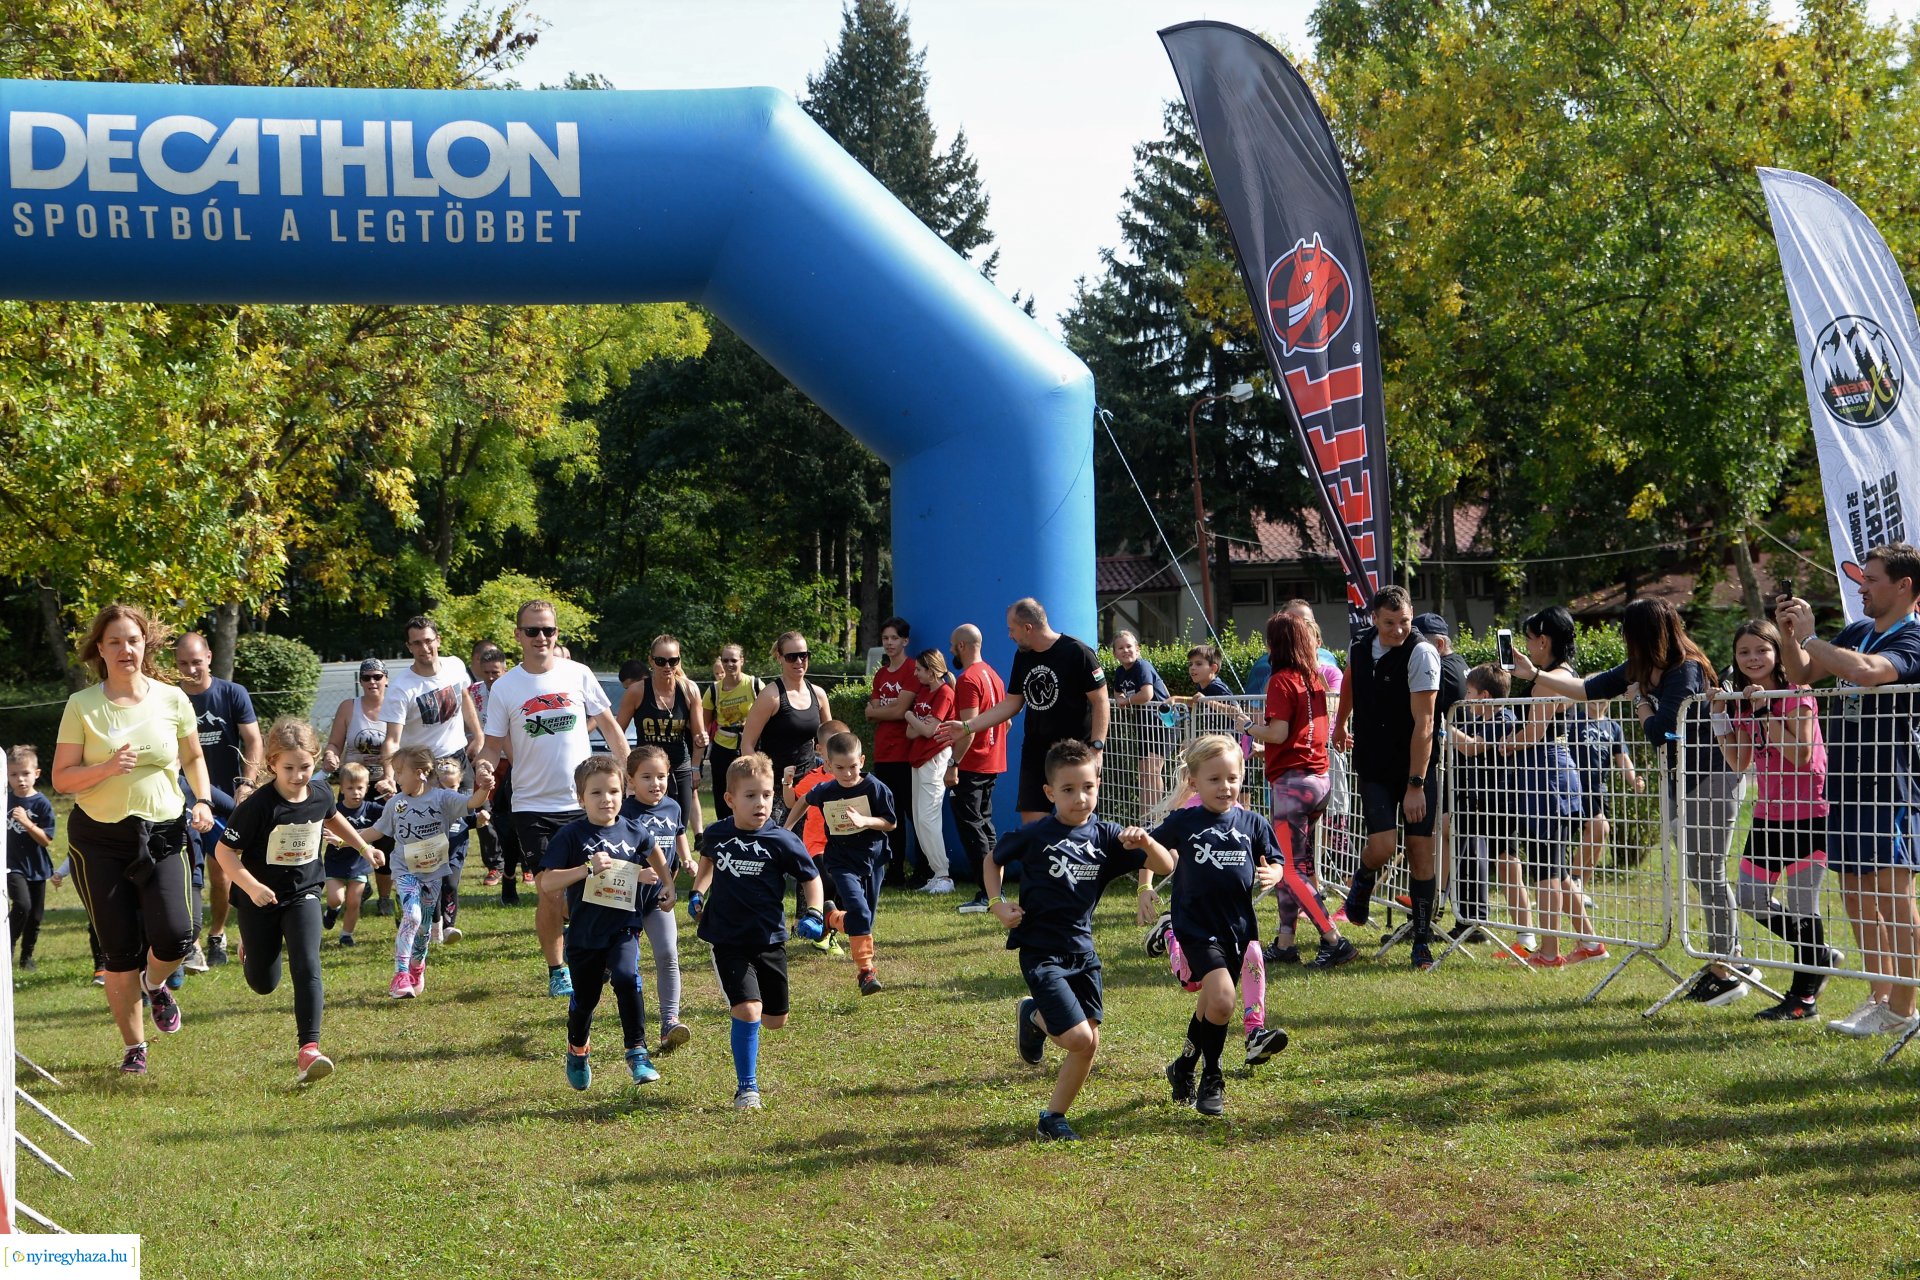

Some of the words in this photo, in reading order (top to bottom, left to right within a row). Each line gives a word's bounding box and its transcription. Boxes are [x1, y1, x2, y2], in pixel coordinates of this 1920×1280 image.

[9, 111, 581, 198] DECATHLON
[13, 199, 251, 241] SPORTBÓL
[280, 210, 300, 241] A
[330, 202, 581, 242] LEGTÖBBET
[642, 717, 686, 737] GYM
[612, 878, 626, 887] 122
